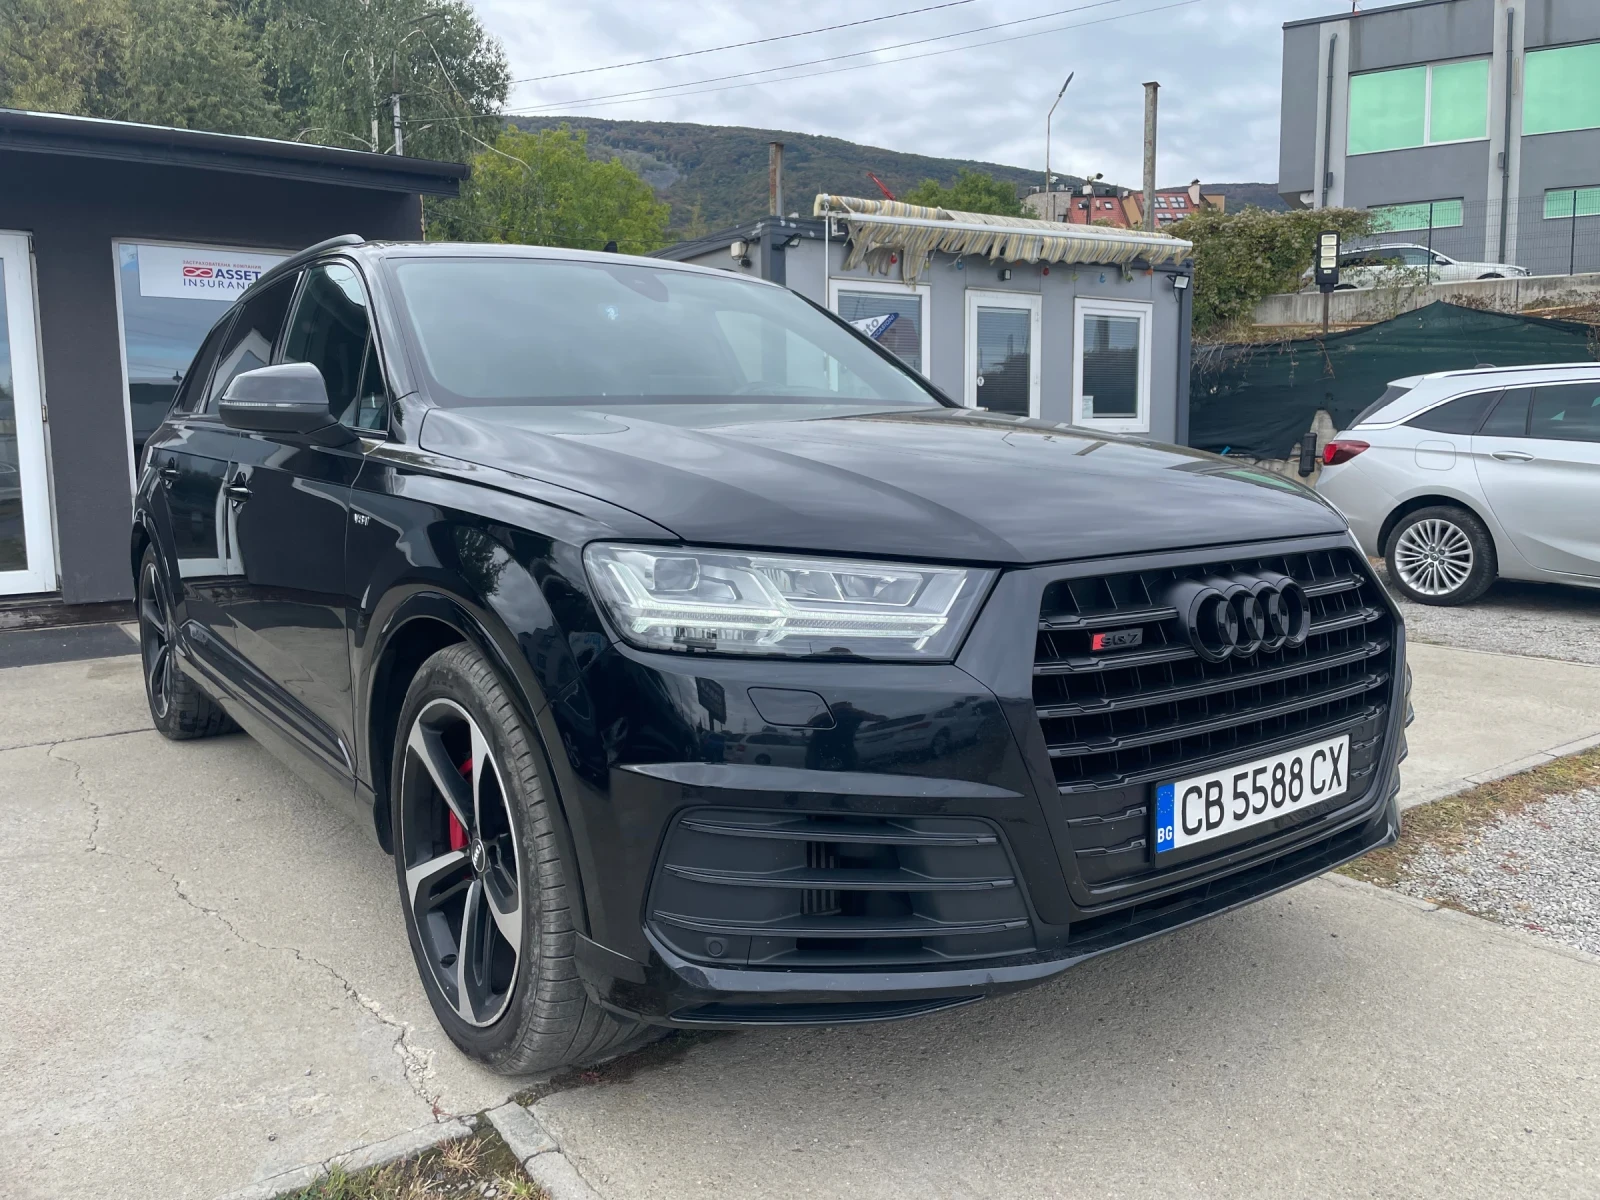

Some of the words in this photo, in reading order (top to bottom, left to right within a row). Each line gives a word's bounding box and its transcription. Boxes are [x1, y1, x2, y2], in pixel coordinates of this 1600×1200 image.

[215, 268, 261, 281] ASSET
[1100, 633, 1139, 648] SQ7
[1181, 780, 1225, 836] CB
[1232, 756, 1304, 821] 5588
[1310, 742, 1344, 796] CX
[1157, 825, 1173, 843] BG
